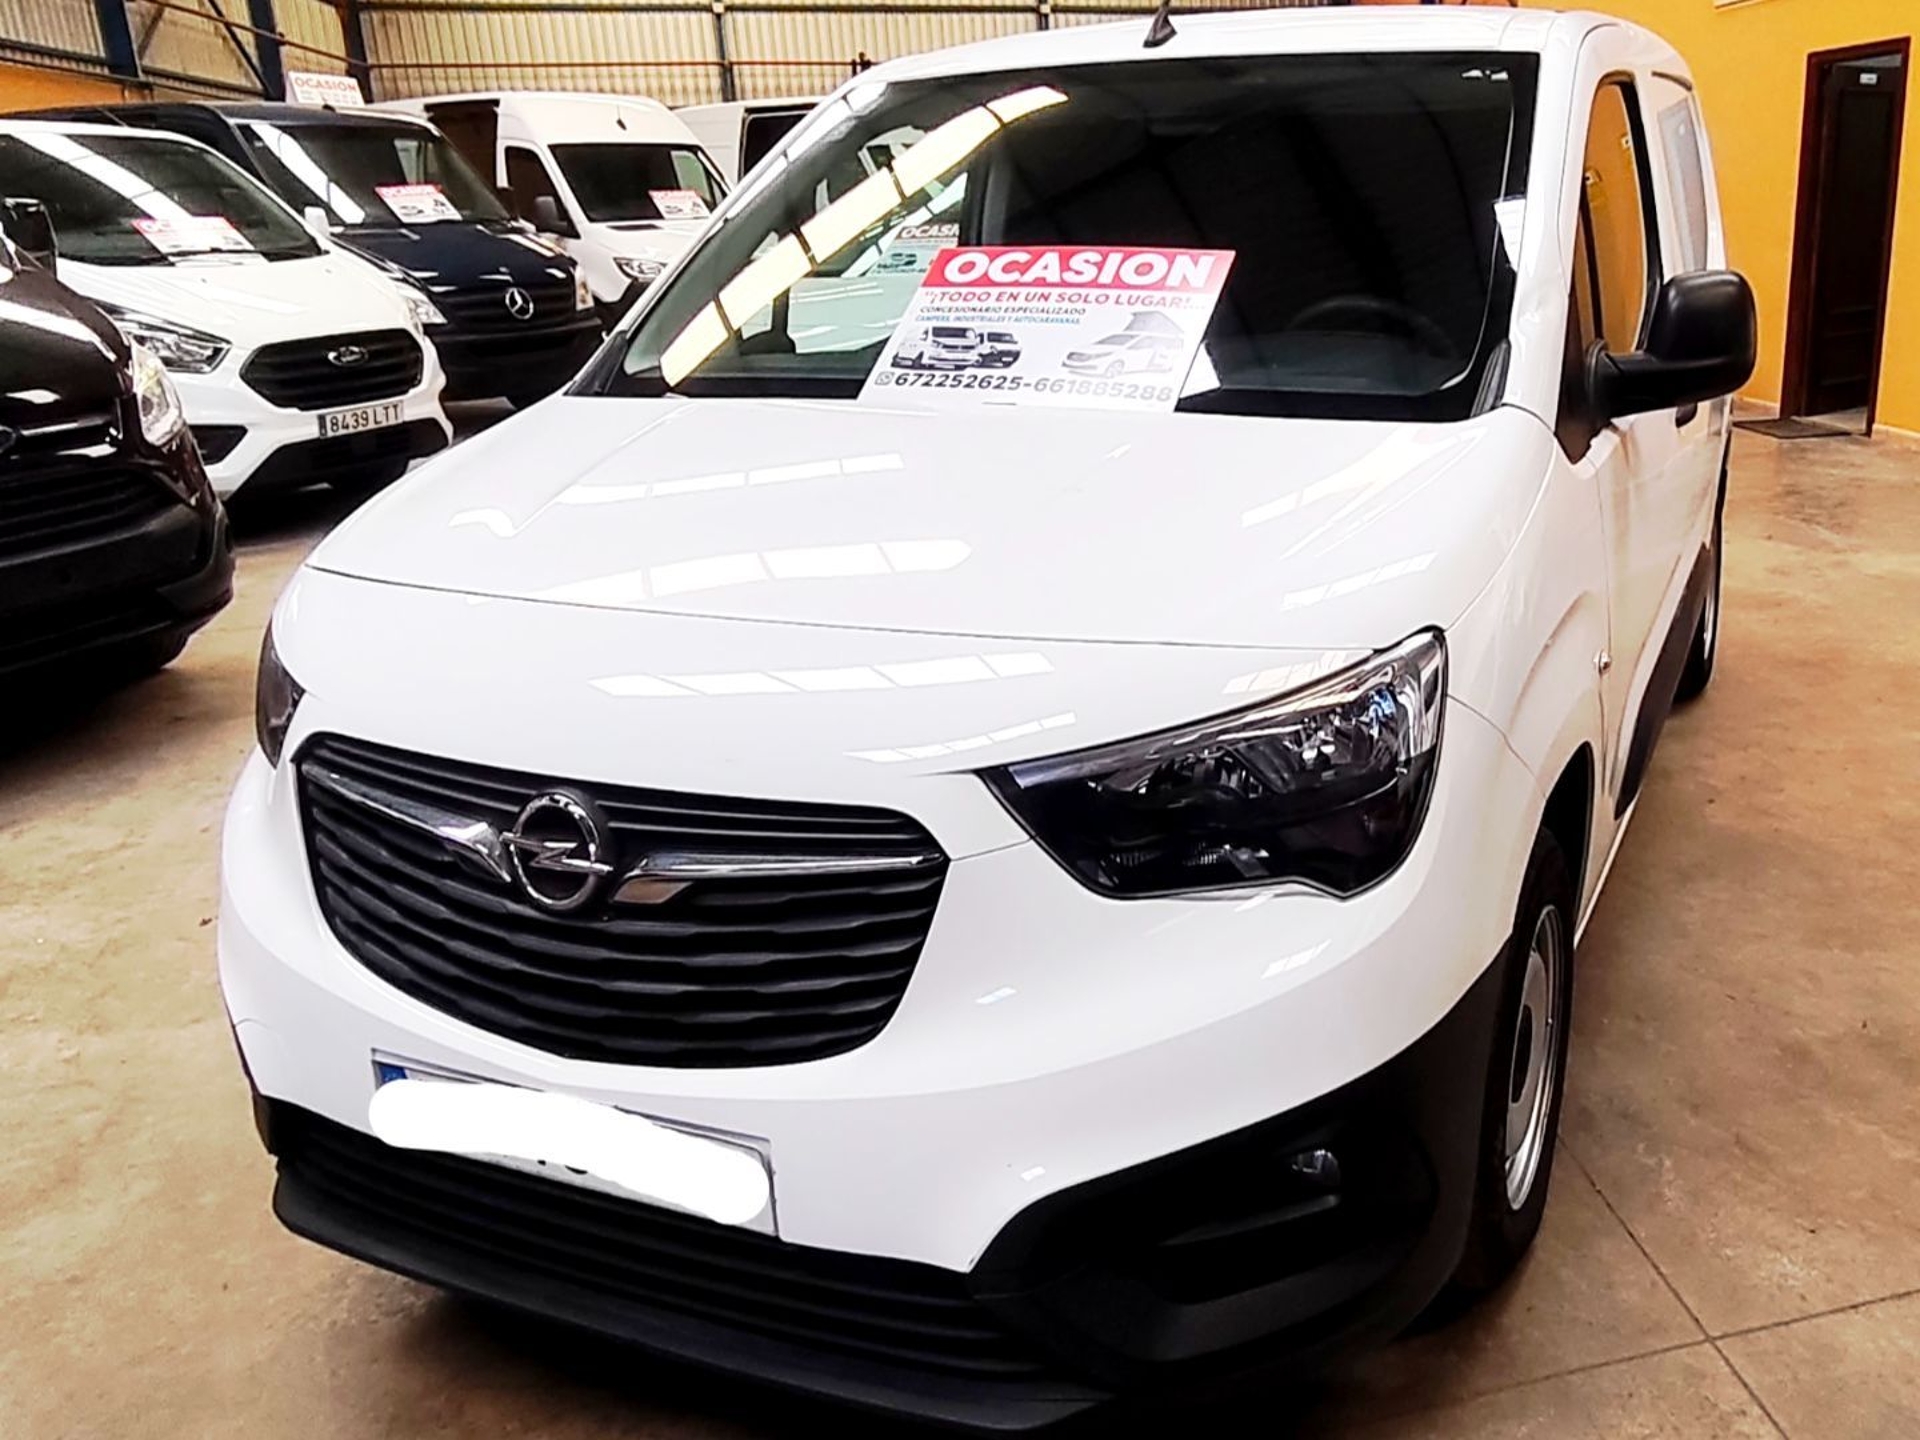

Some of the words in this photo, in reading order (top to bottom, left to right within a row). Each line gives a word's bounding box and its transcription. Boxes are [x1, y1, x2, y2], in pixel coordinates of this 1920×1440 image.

[944, 251, 1215, 288] OCASION
[995, 291, 1021, 303] EN
[1024, 291, 1051, 304] UN
[1054, 292, 1110, 305] SOLO
[919, 306, 1001, 314] CONCESIONARIO
[1003, 306, 1087, 316] ESPECIALIZADO
[330, 410, 369, 433] 8439
[373, 404, 399, 425] LTT
